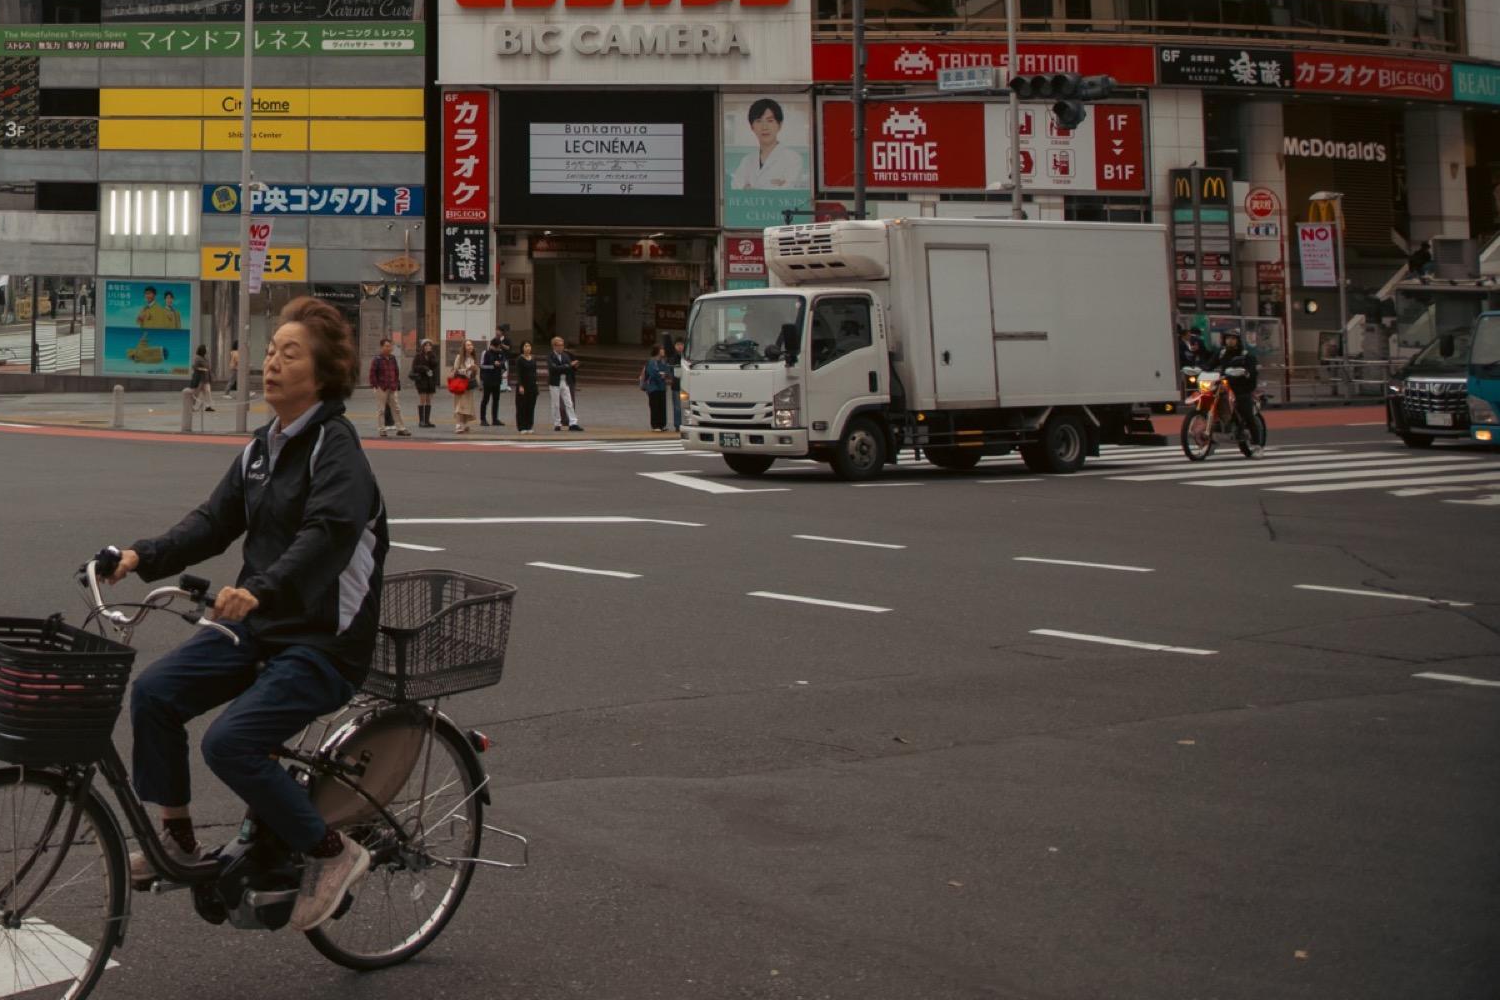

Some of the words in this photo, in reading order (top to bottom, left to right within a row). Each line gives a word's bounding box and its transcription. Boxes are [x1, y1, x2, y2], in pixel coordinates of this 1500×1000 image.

[496, 24, 562, 57] BIC
[572, 23, 750, 57] CAMERA
[938, 53, 992, 69] TAITO
[1000, 54, 1079, 73] STATION
[1161, 50, 1180, 62] 6F
[1296, 62, 1376, 87] カラオケ
[5, 121, 25, 137] 3F
[565, 124, 648, 134] Bunkamura
[1107, 114, 1128, 131] 1F
[258, 131, 282, 139] Center
[453, 101, 480, 205] カラオケ
[565, 138, 647, 154] LECINÉMA
[1283, 136, 1387, 162] McDonald's
[871, 141, 938, 170] GAME
[874, 172, 899, 182] TAITO
[900, 172, 939, 182] STATION
[1104, 164, 1135, 180] B1F
[580, 184, 592, 193] 7F
[619, 184, 633, 193] 9F
